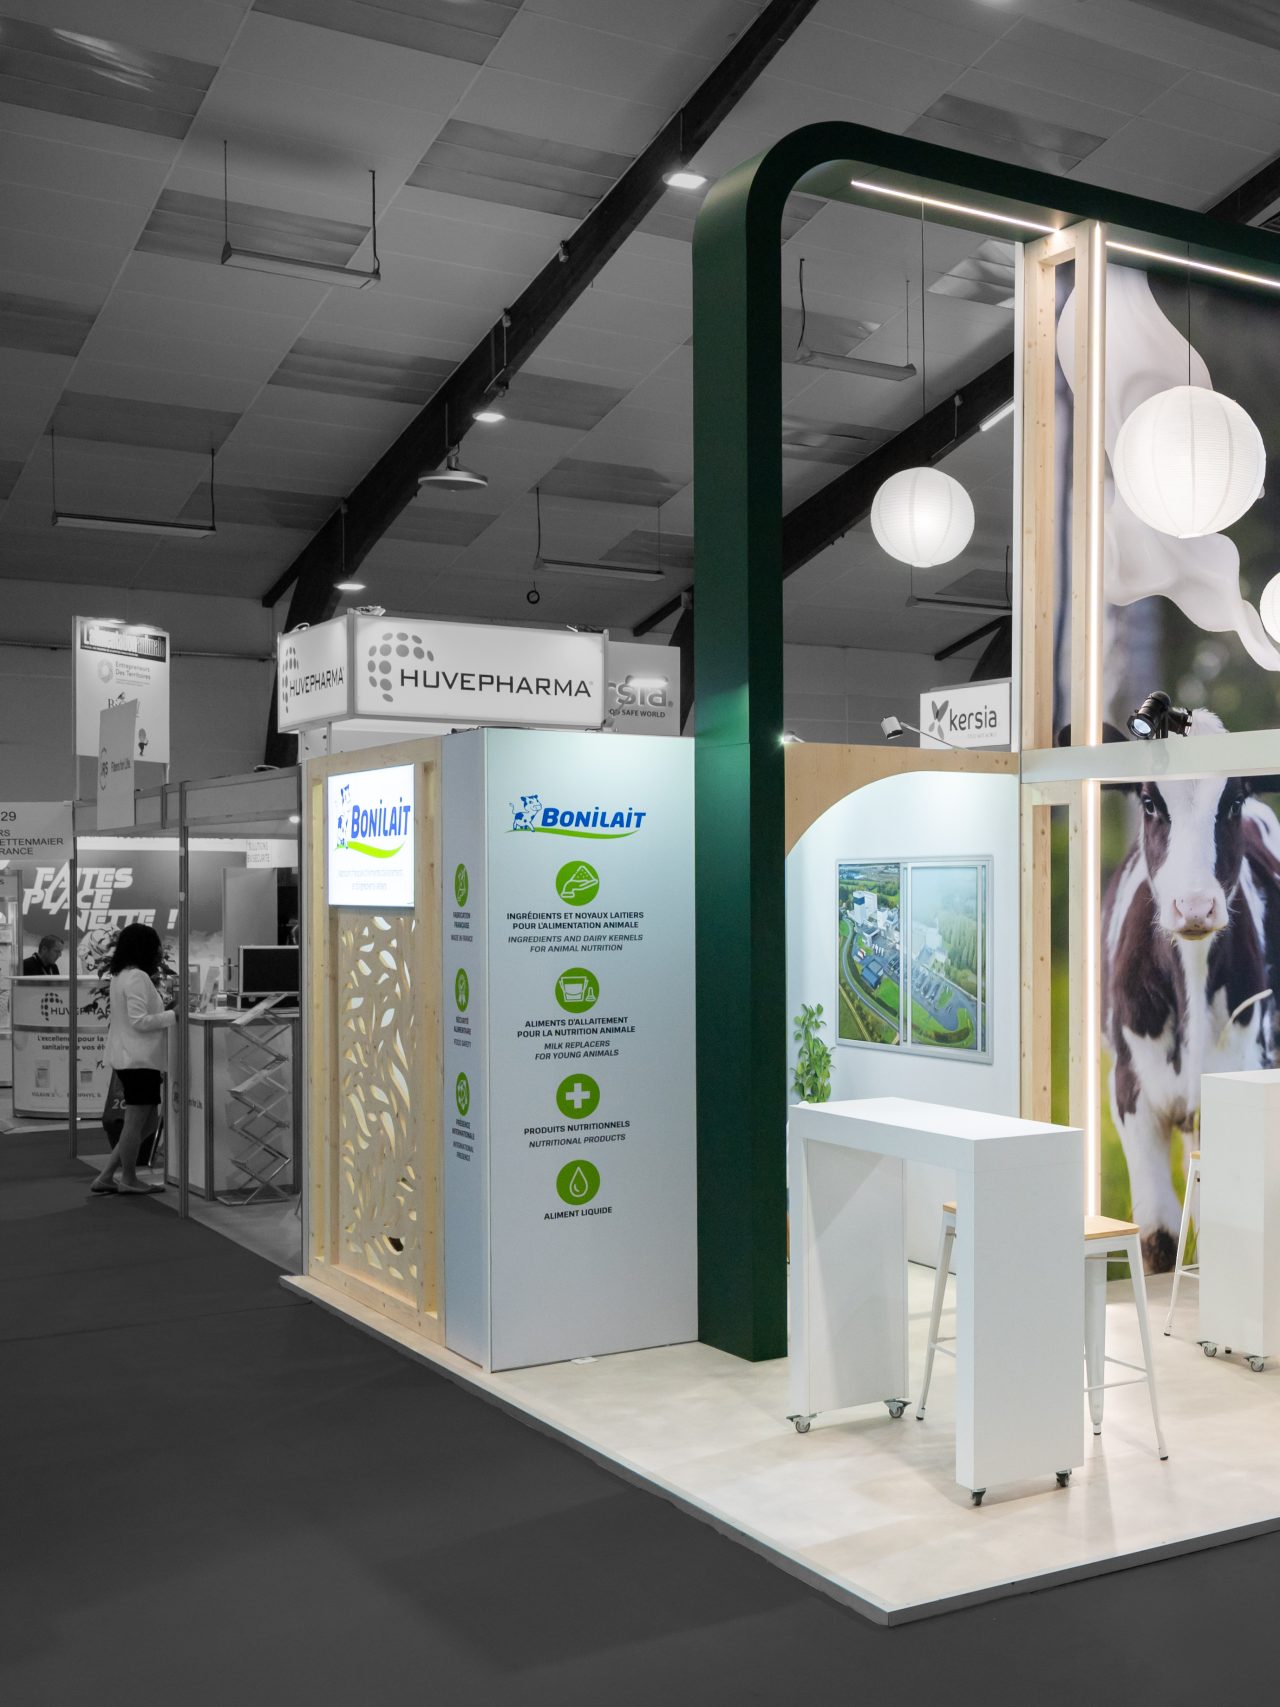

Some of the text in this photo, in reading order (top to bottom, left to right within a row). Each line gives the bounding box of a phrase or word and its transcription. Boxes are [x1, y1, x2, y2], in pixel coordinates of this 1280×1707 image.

[289, 667, 344, 697] HUVEPHARMA
[400, 669, 591, 698] HUVEPHARMA
[621, 709, 639, 717] SAFE
[639, 710, 666, 718] WORLD
[949, 705, 998, 732] kersia
[0, 811, 17, 822] 29
[22, 888, 113, 915] PLACE
[64, 908, 179, 932] NETTE !
[506, 911, 644, 920] INGRÉDIENTS ET NOYAUX LAITIERS
[512, 921, 639, 930] POUR L'ALIMENTATION ANIMALE
[507, 935, 562, 943] INGREDIENTS
[583, 934, 607, 942] DAIRY
[530, 945, 546, 953] FOR
[580, 944, 623, 952] NUTRITION
[524, 1016, 629, 1028] ALIMENTS D'ALLAITEMENT
[517, 1026, 636, 1038] POUR LA NUTRITION ANIMALE
[544, 1040, 611, 1050] MILK REPLACERS
[534, 1049, 620, 1061] FOR YOUNG ANIMALS
[524, 1120, 631, 1135] PRODUITS NUTRITIONNELS
[528, 1133, 626, 1148] NUTRITIONAL PRODUCTS
[543, 1206, 613, 1221] ALIMENT LIQUIDE
